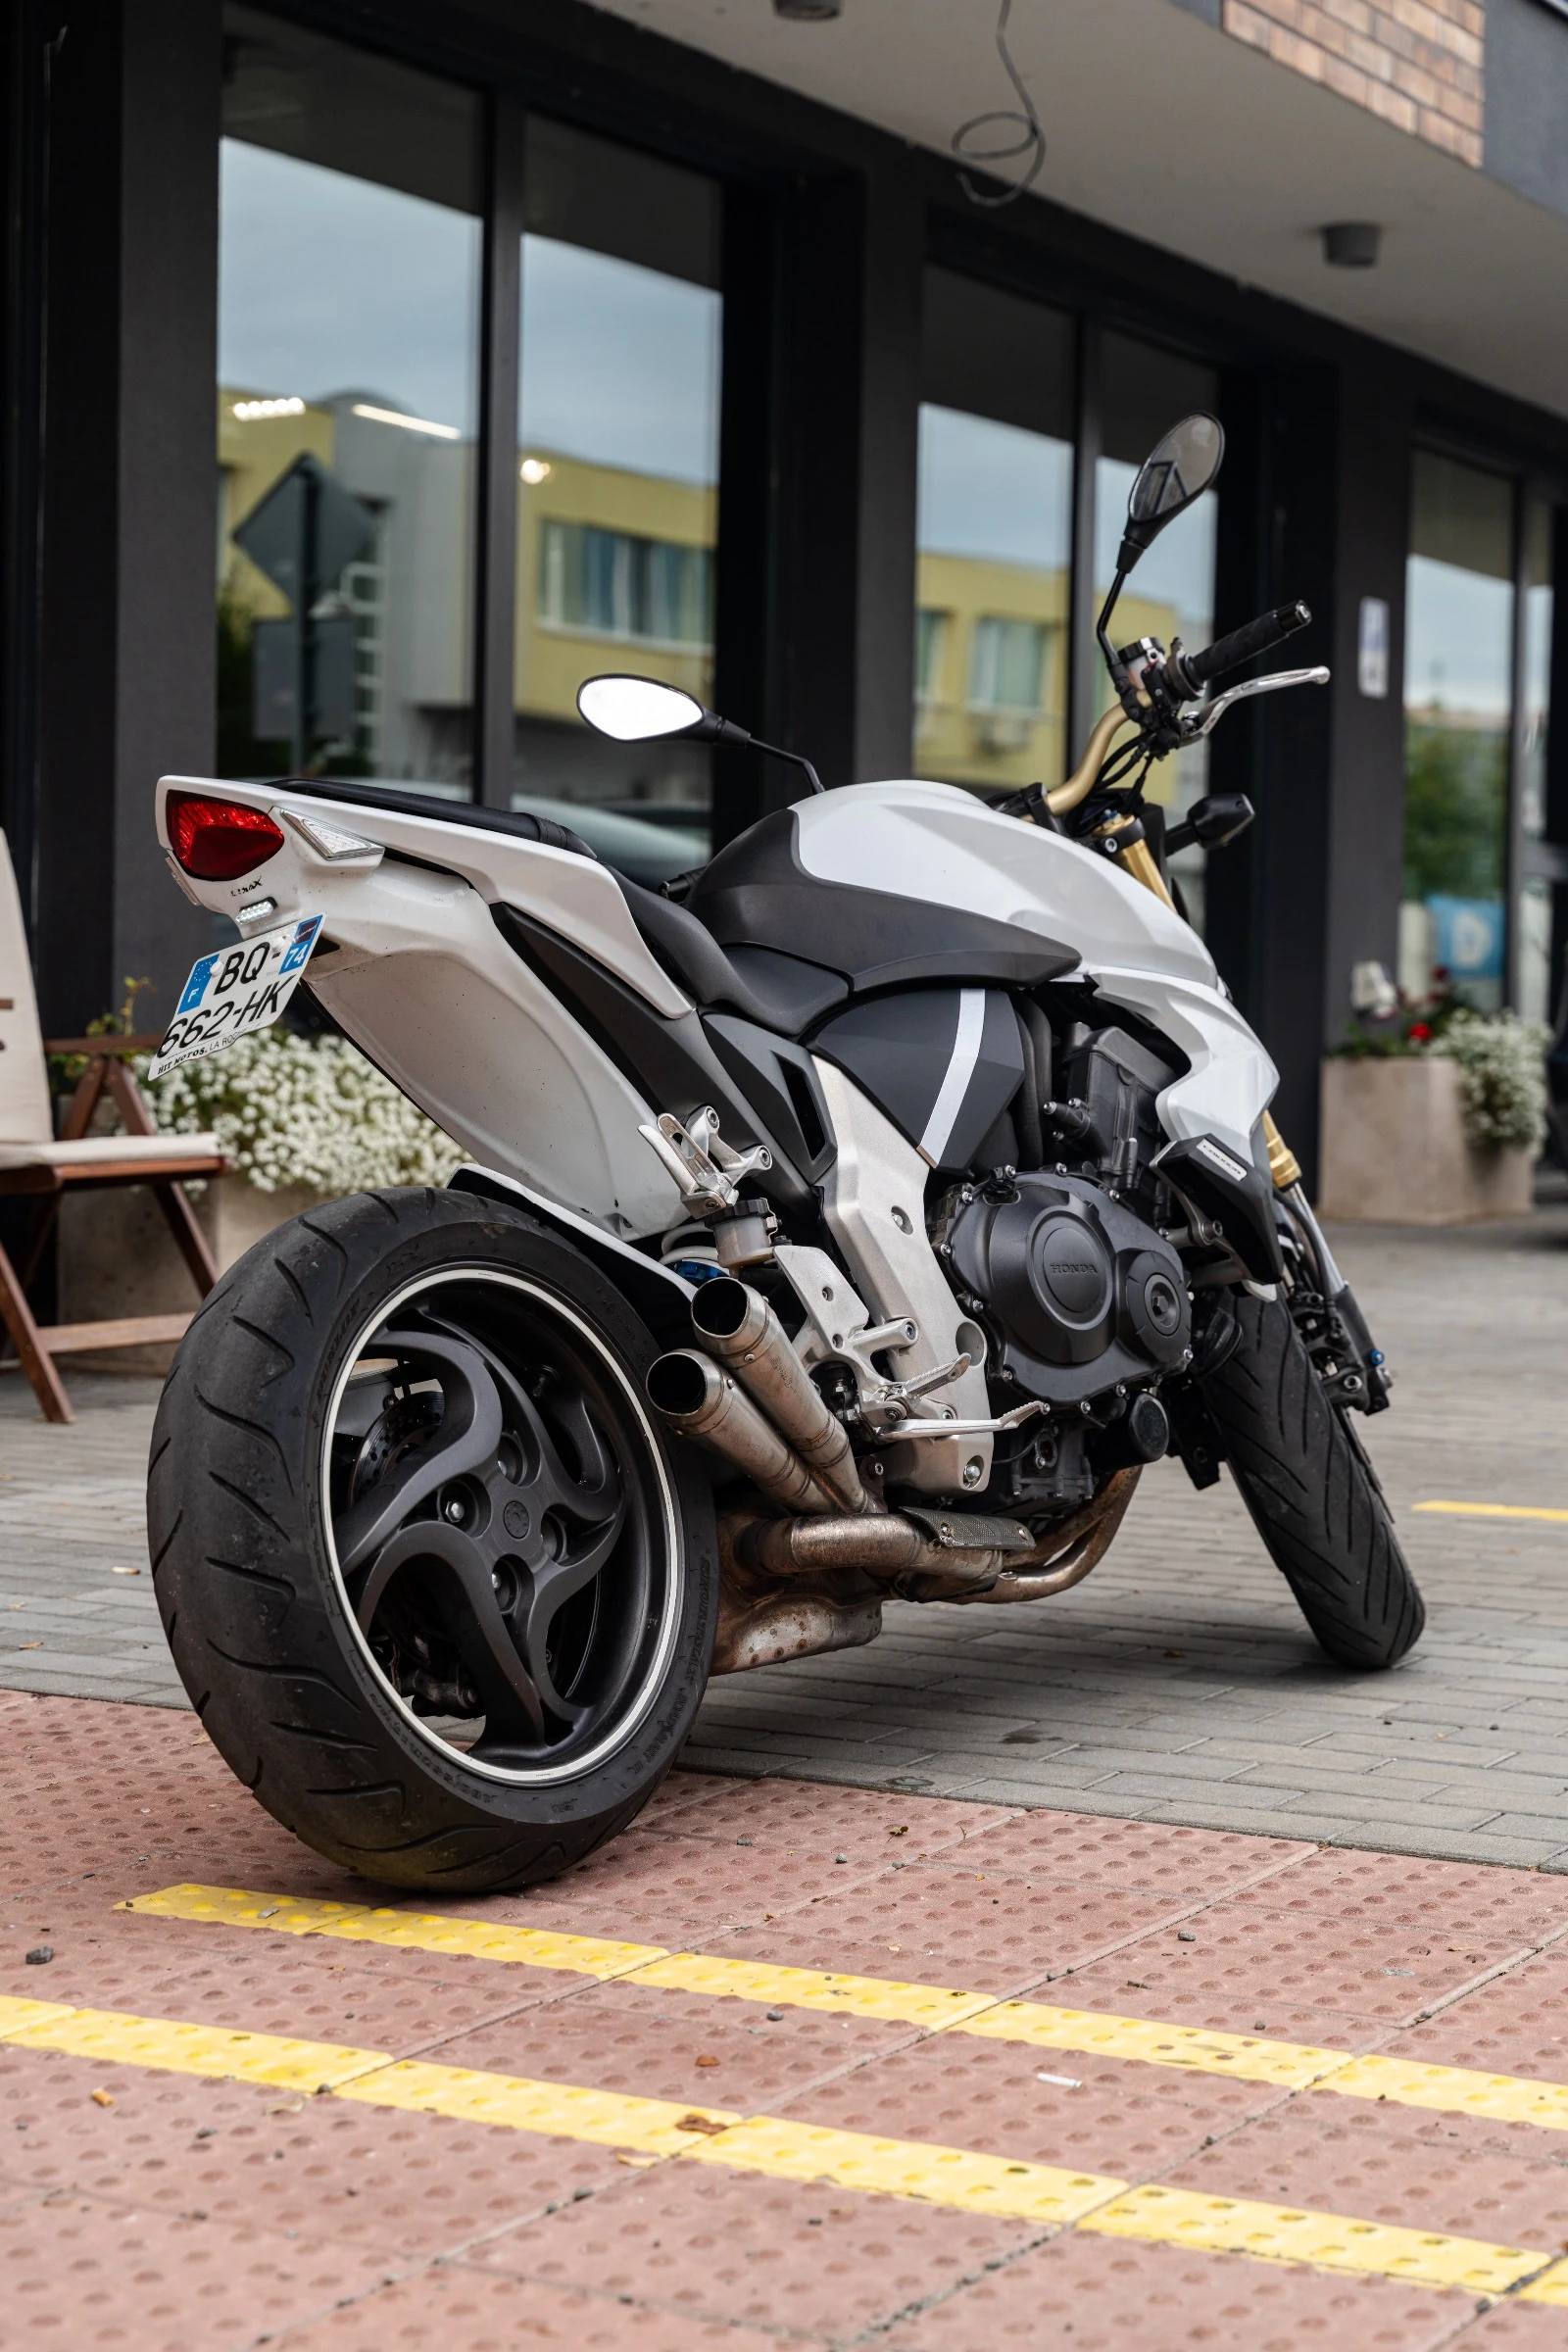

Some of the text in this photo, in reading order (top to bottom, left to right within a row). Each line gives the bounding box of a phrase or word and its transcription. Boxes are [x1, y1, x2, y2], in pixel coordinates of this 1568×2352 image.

[285, 944, 309, 969] 74
[187, 987, 200, 1004] F
[157, 974, 297, 1058] 662-HK
[157, 1061, 172, 1075] HIT
[209, 1042, 220, 1051] LA
[1050, 1263, 1098, 1274] HONDA
